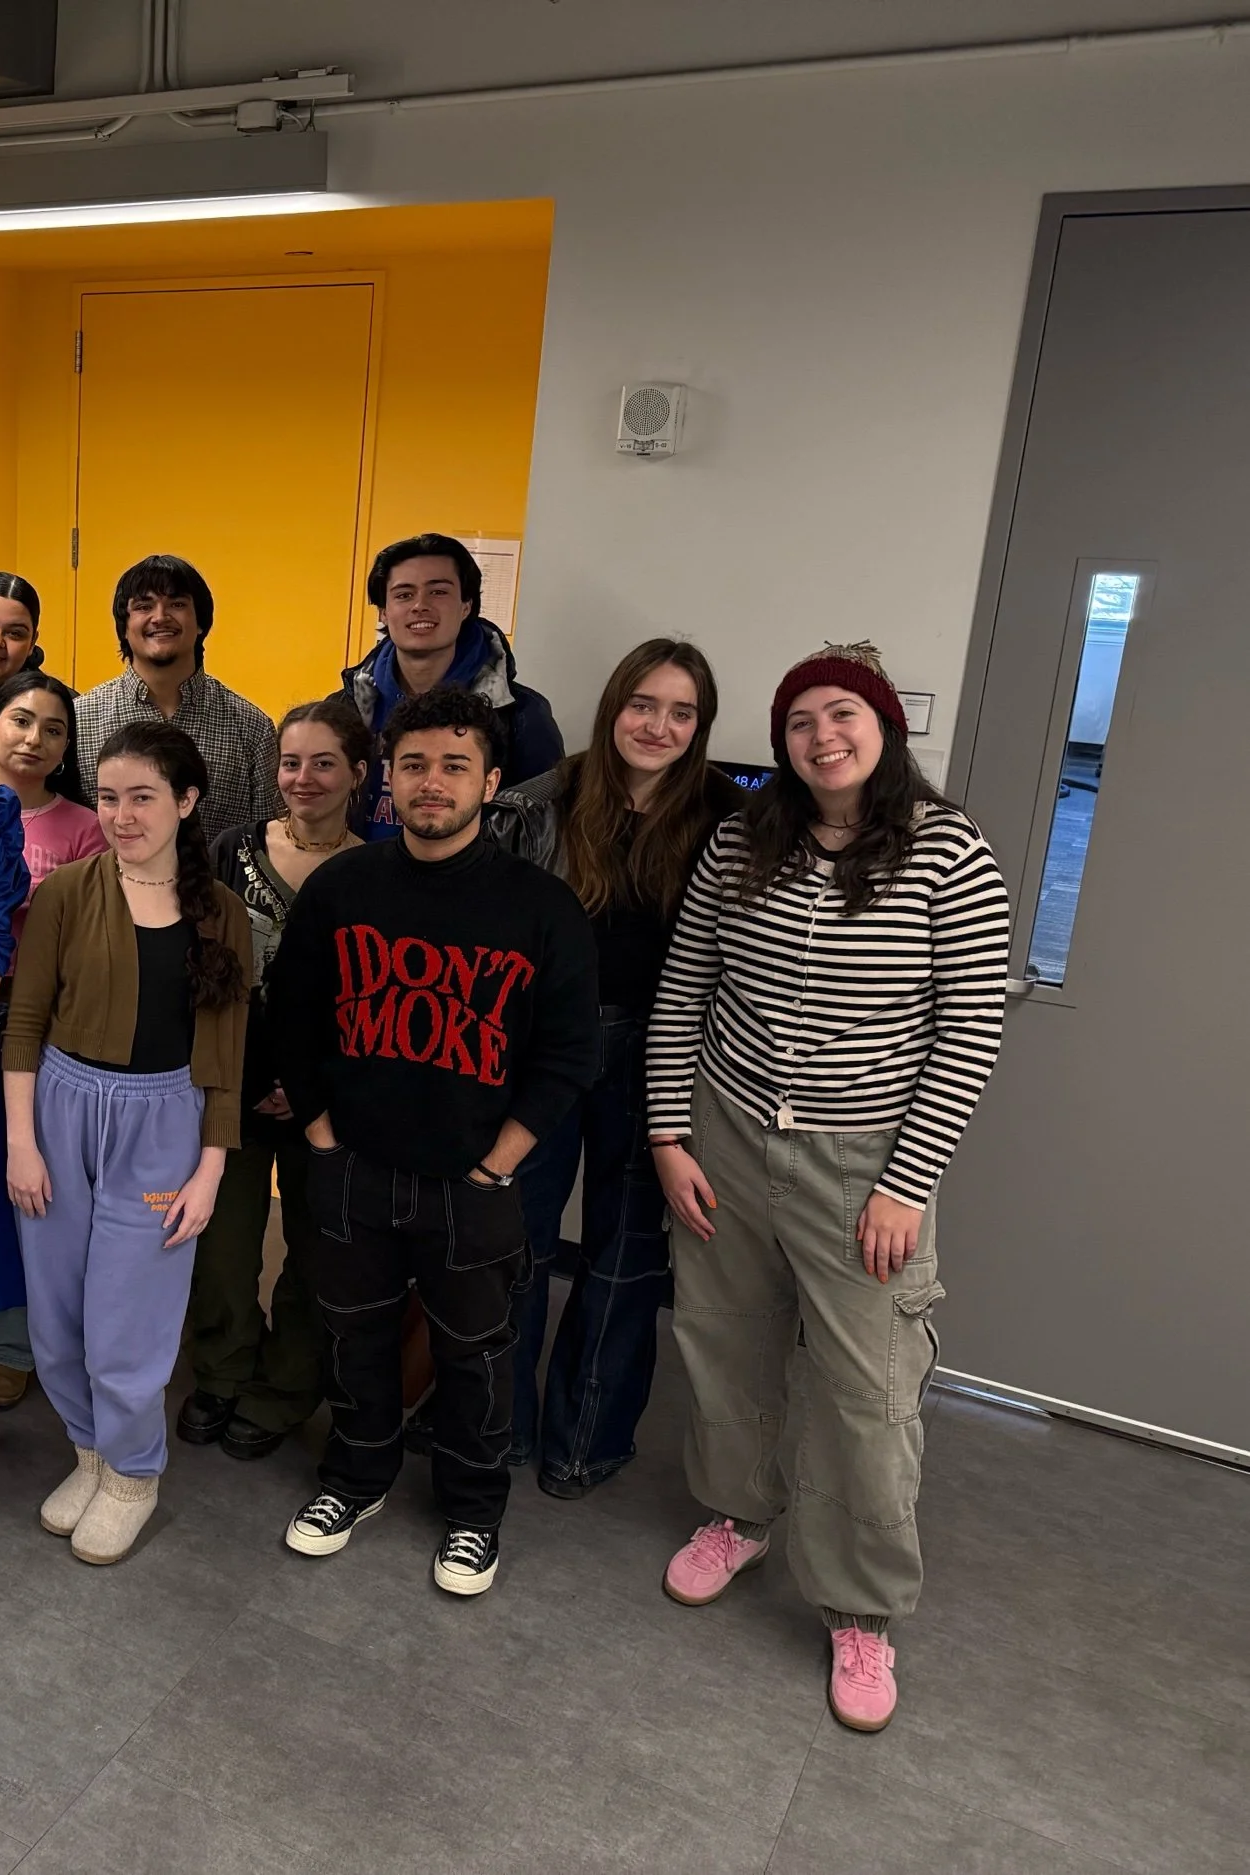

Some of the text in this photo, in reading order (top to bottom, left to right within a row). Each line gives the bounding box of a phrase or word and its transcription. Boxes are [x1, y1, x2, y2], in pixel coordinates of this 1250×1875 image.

[334, 924, 535, 1030] I DON'T
[335, 985, 508, 1087] SMOKE
